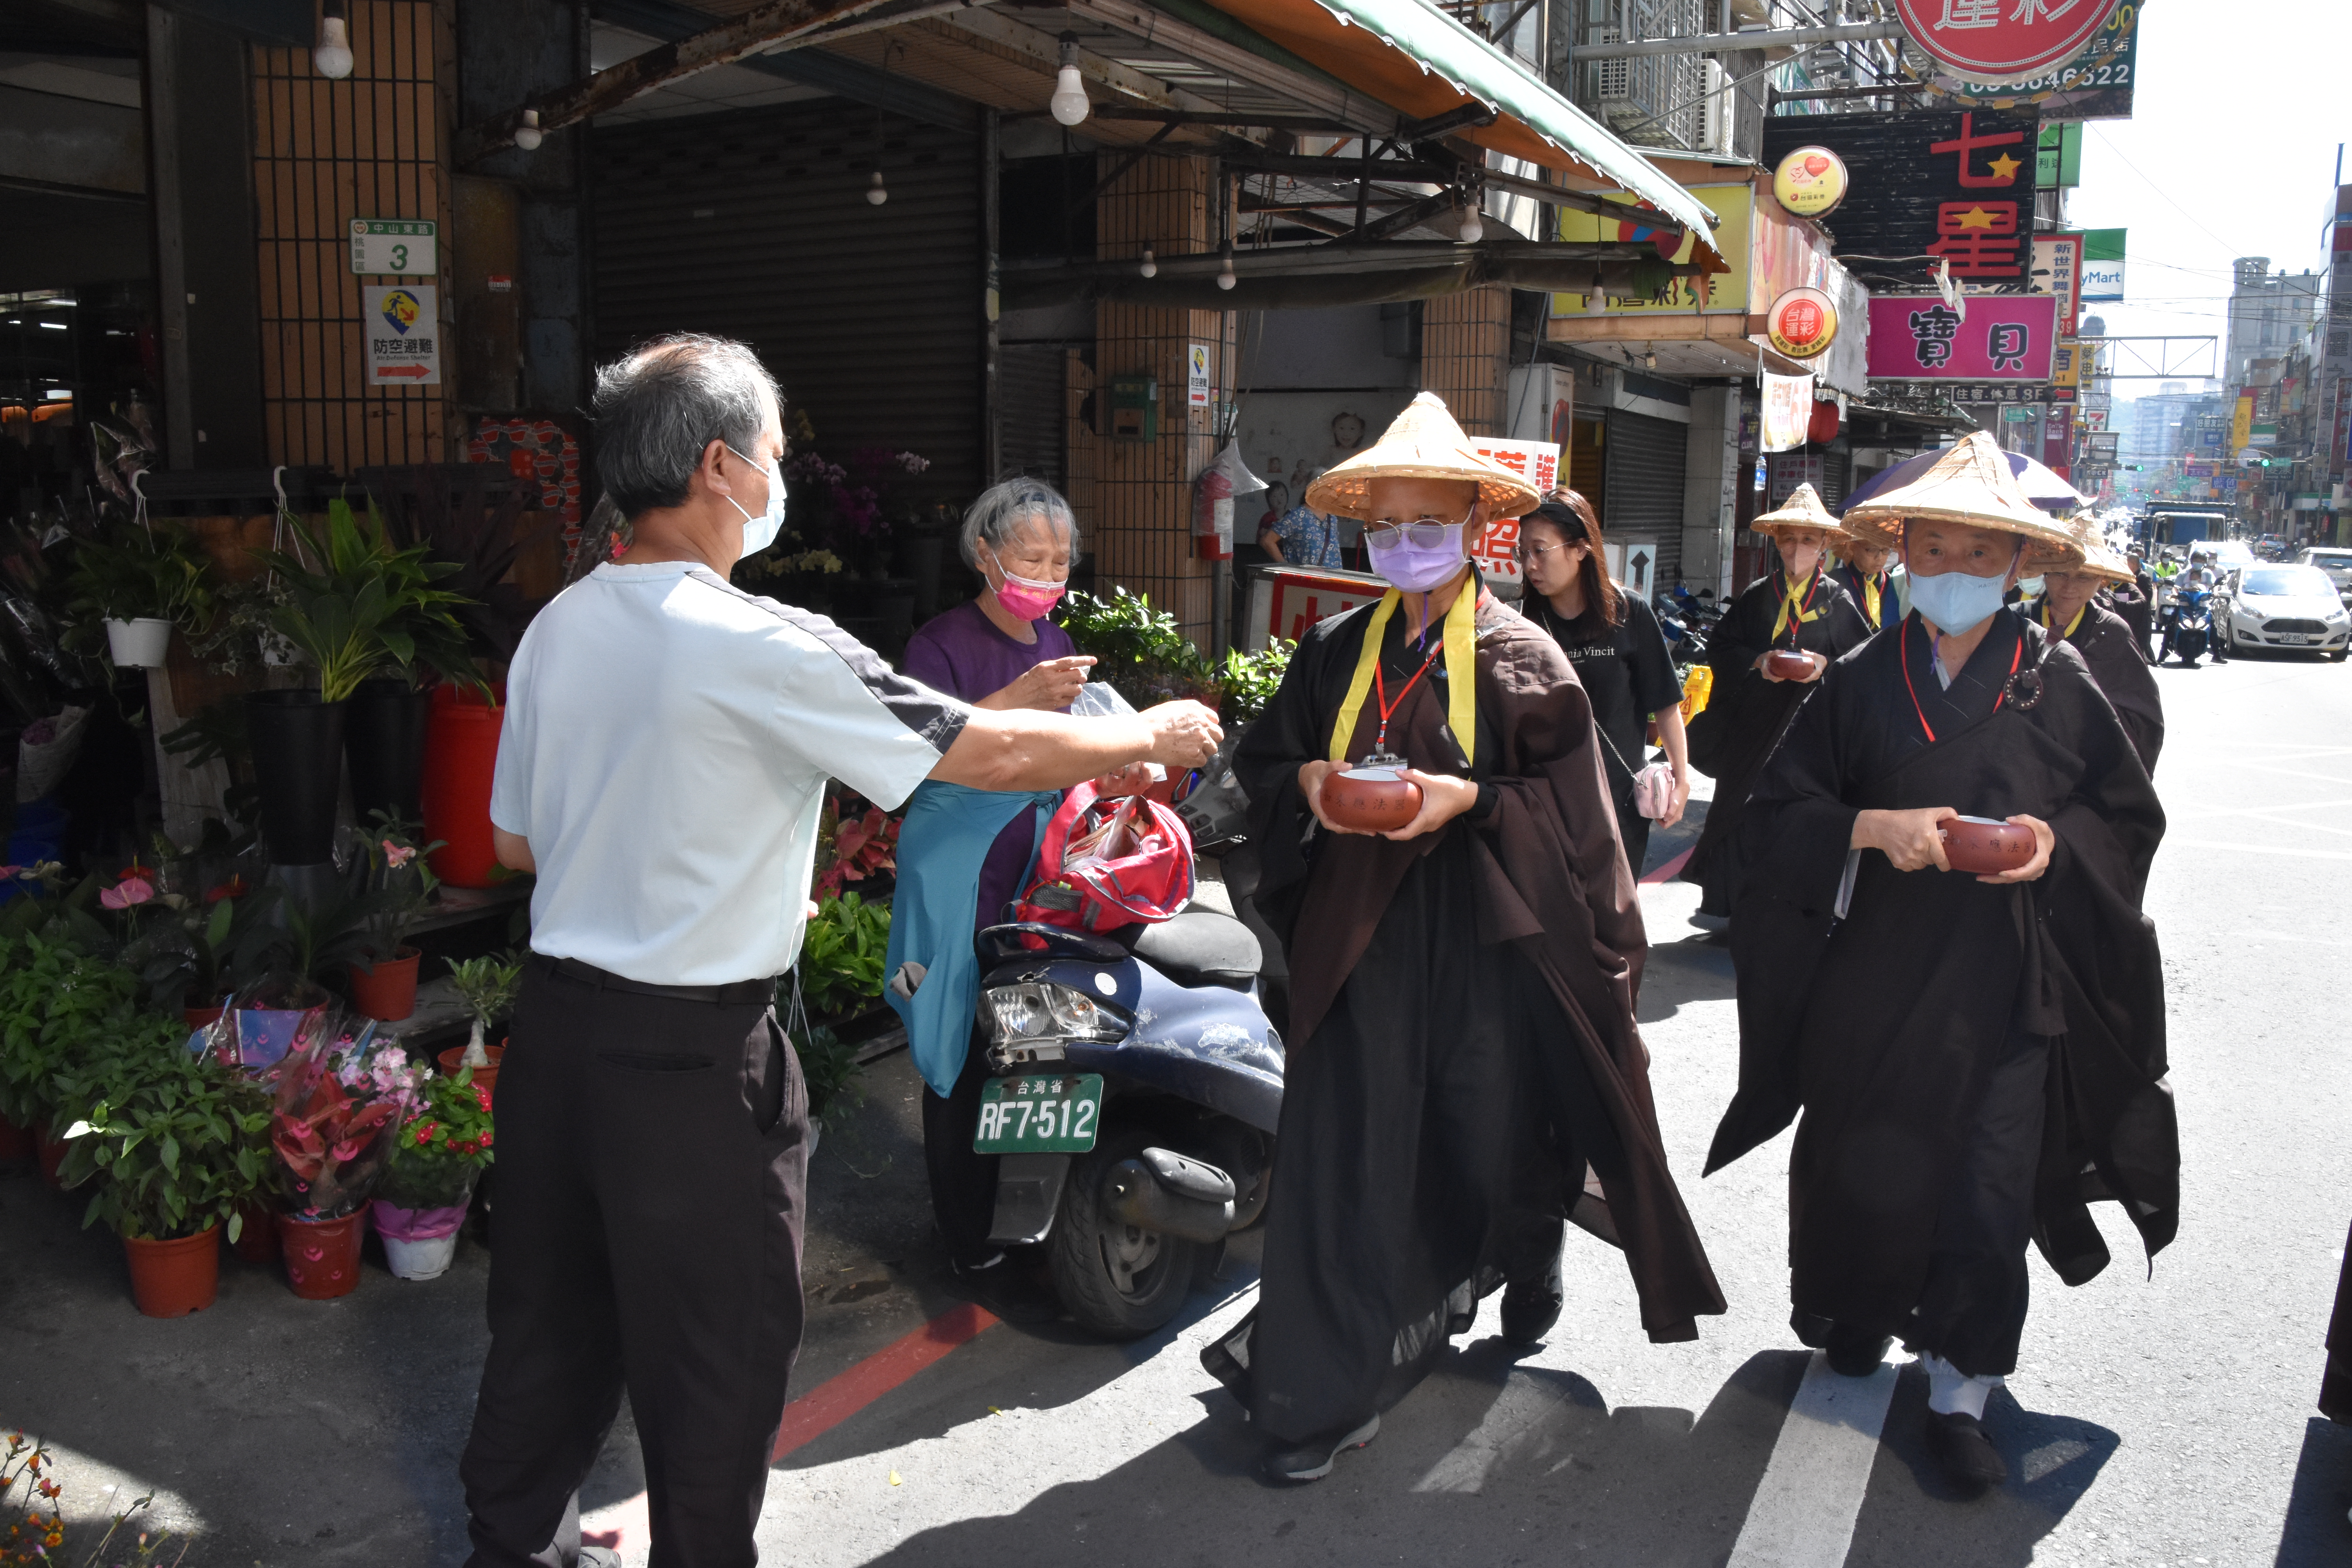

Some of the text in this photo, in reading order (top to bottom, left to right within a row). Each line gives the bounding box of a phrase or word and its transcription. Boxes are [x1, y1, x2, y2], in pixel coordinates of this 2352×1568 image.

[1926, 112, 2024, 277] 七星
[374, 223, 428, 234] 中山東路
[354, 237, 365, 271] 桃園區
[389, 245, 408, 270] 3
[1786, 322, 1815, 337] 運彩
[1909, 304, 2029, 371] 寶貝
[374, 339, 433, 354] 防空避難
[1583, 646, 1615, 656] Vincit
[1018, 1080, 1063, 1095] 台灣省
